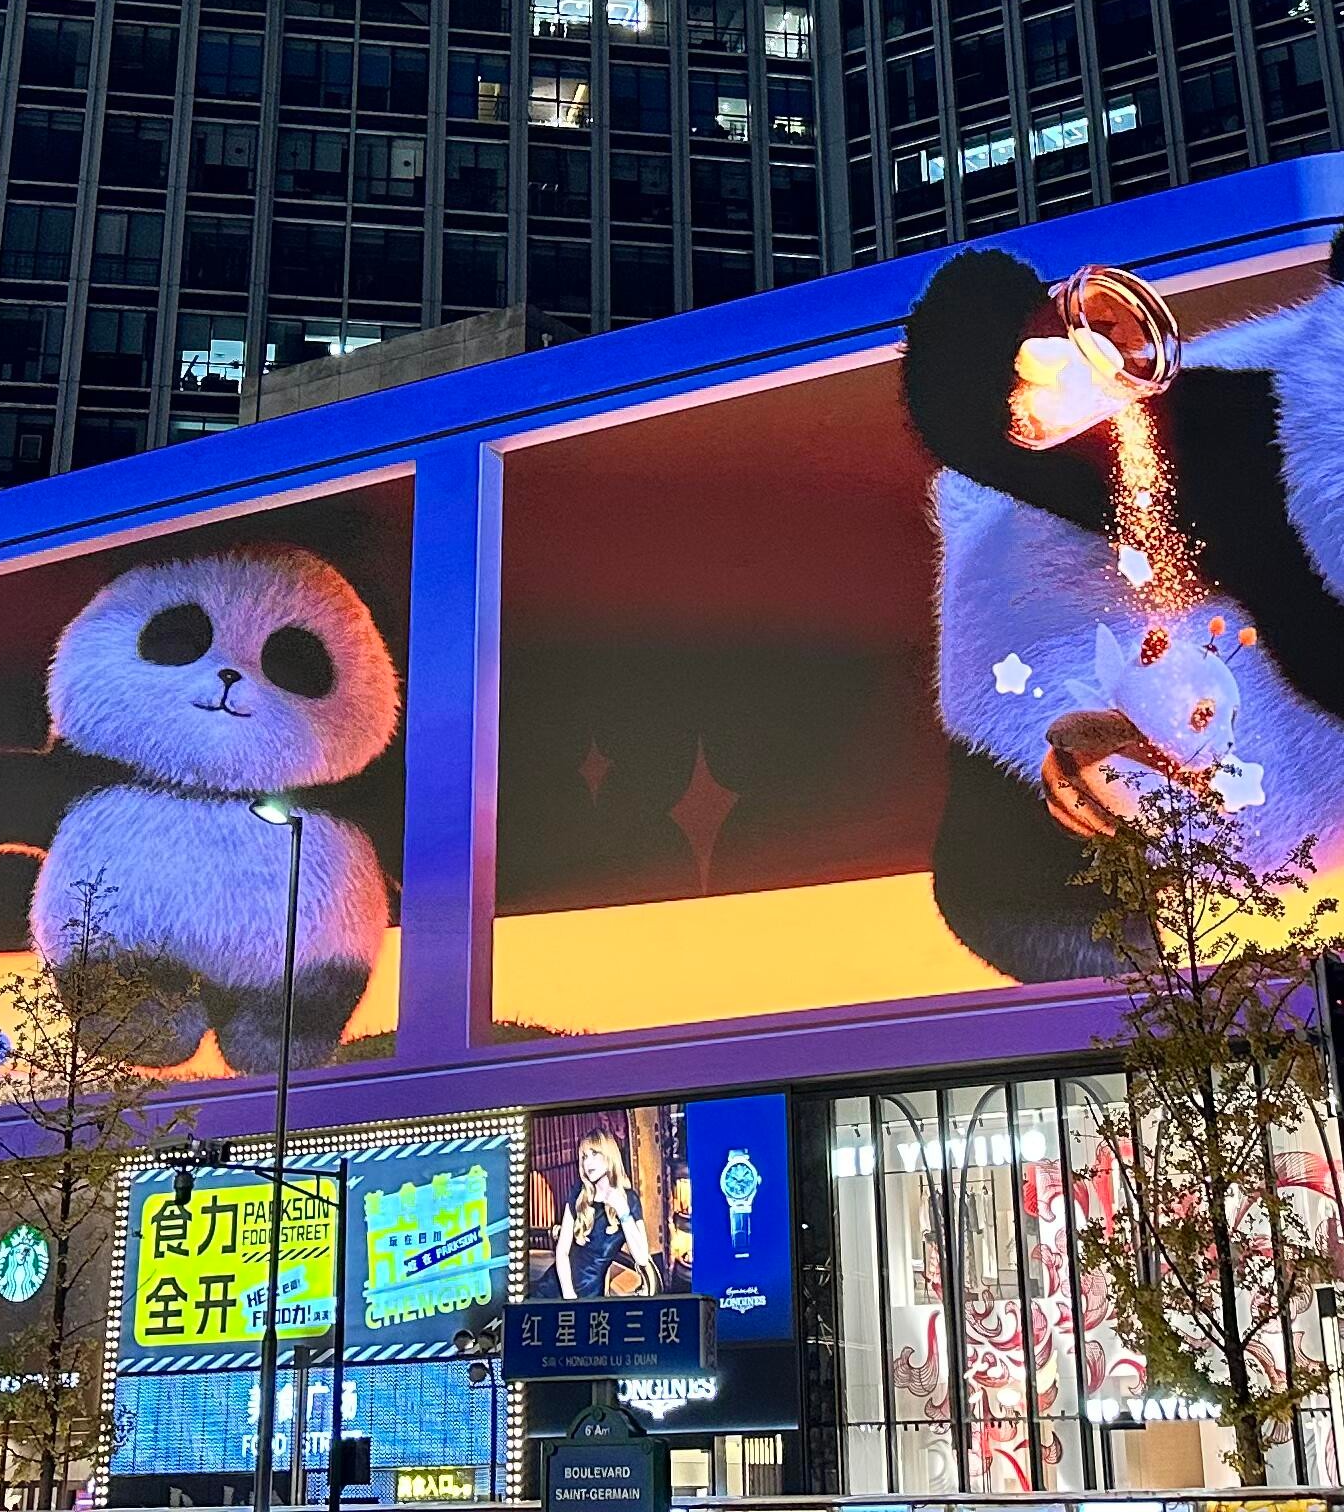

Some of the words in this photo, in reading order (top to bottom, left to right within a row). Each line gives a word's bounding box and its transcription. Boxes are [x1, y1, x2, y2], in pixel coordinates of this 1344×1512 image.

[243, 1196, 330, 1225] PAKSON
[151, 1195, 239, 1259] 食力
[281, 1223, 330, 1243] STREET
[436, 1231, 478, 1259] PARKSON
[144, 1274, 237, 1336] 全开
[365, 1279, 492, 1330] CHENGDU
[521, 1307, 680, 1346] 红星路三段
[566, 1355, 607, 1367] HONGXING
[610, 1355, 622, 1366] LU
[625, 1354, 632, 1366] 3
[634, 1353, 658, 1366] DUAN
[617, 1378, 718, 1402] ONGINES
[564, 1466, 630, 1479] BOULEVARD
[555, 1488, 640, 1500] SAINT-GERMAIN
